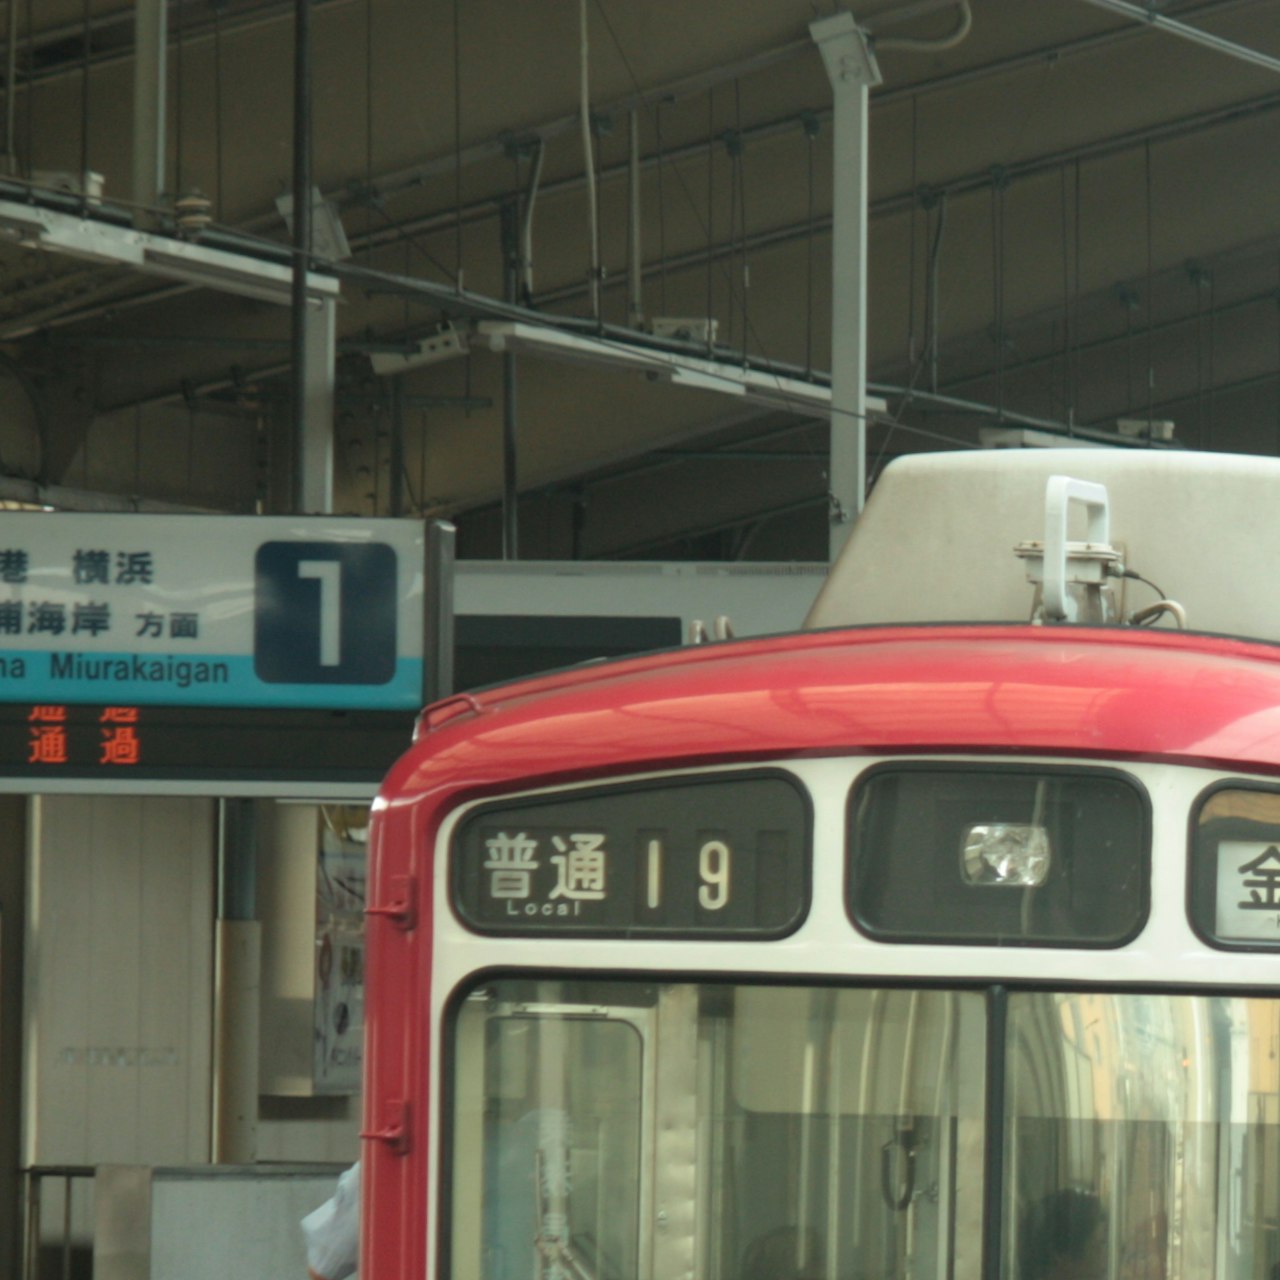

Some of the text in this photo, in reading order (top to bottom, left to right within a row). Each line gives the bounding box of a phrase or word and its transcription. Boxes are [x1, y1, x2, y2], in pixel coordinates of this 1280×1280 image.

[72, 549, 155, 585] 横浜
[135, 612, 199, 639] 方面
[298, 560, 341, 667] 1
[50, 652, 229, 687] Miurakaigan
[483, 832, 606, 900] 普通
[506, 900, 581, 916] Local
